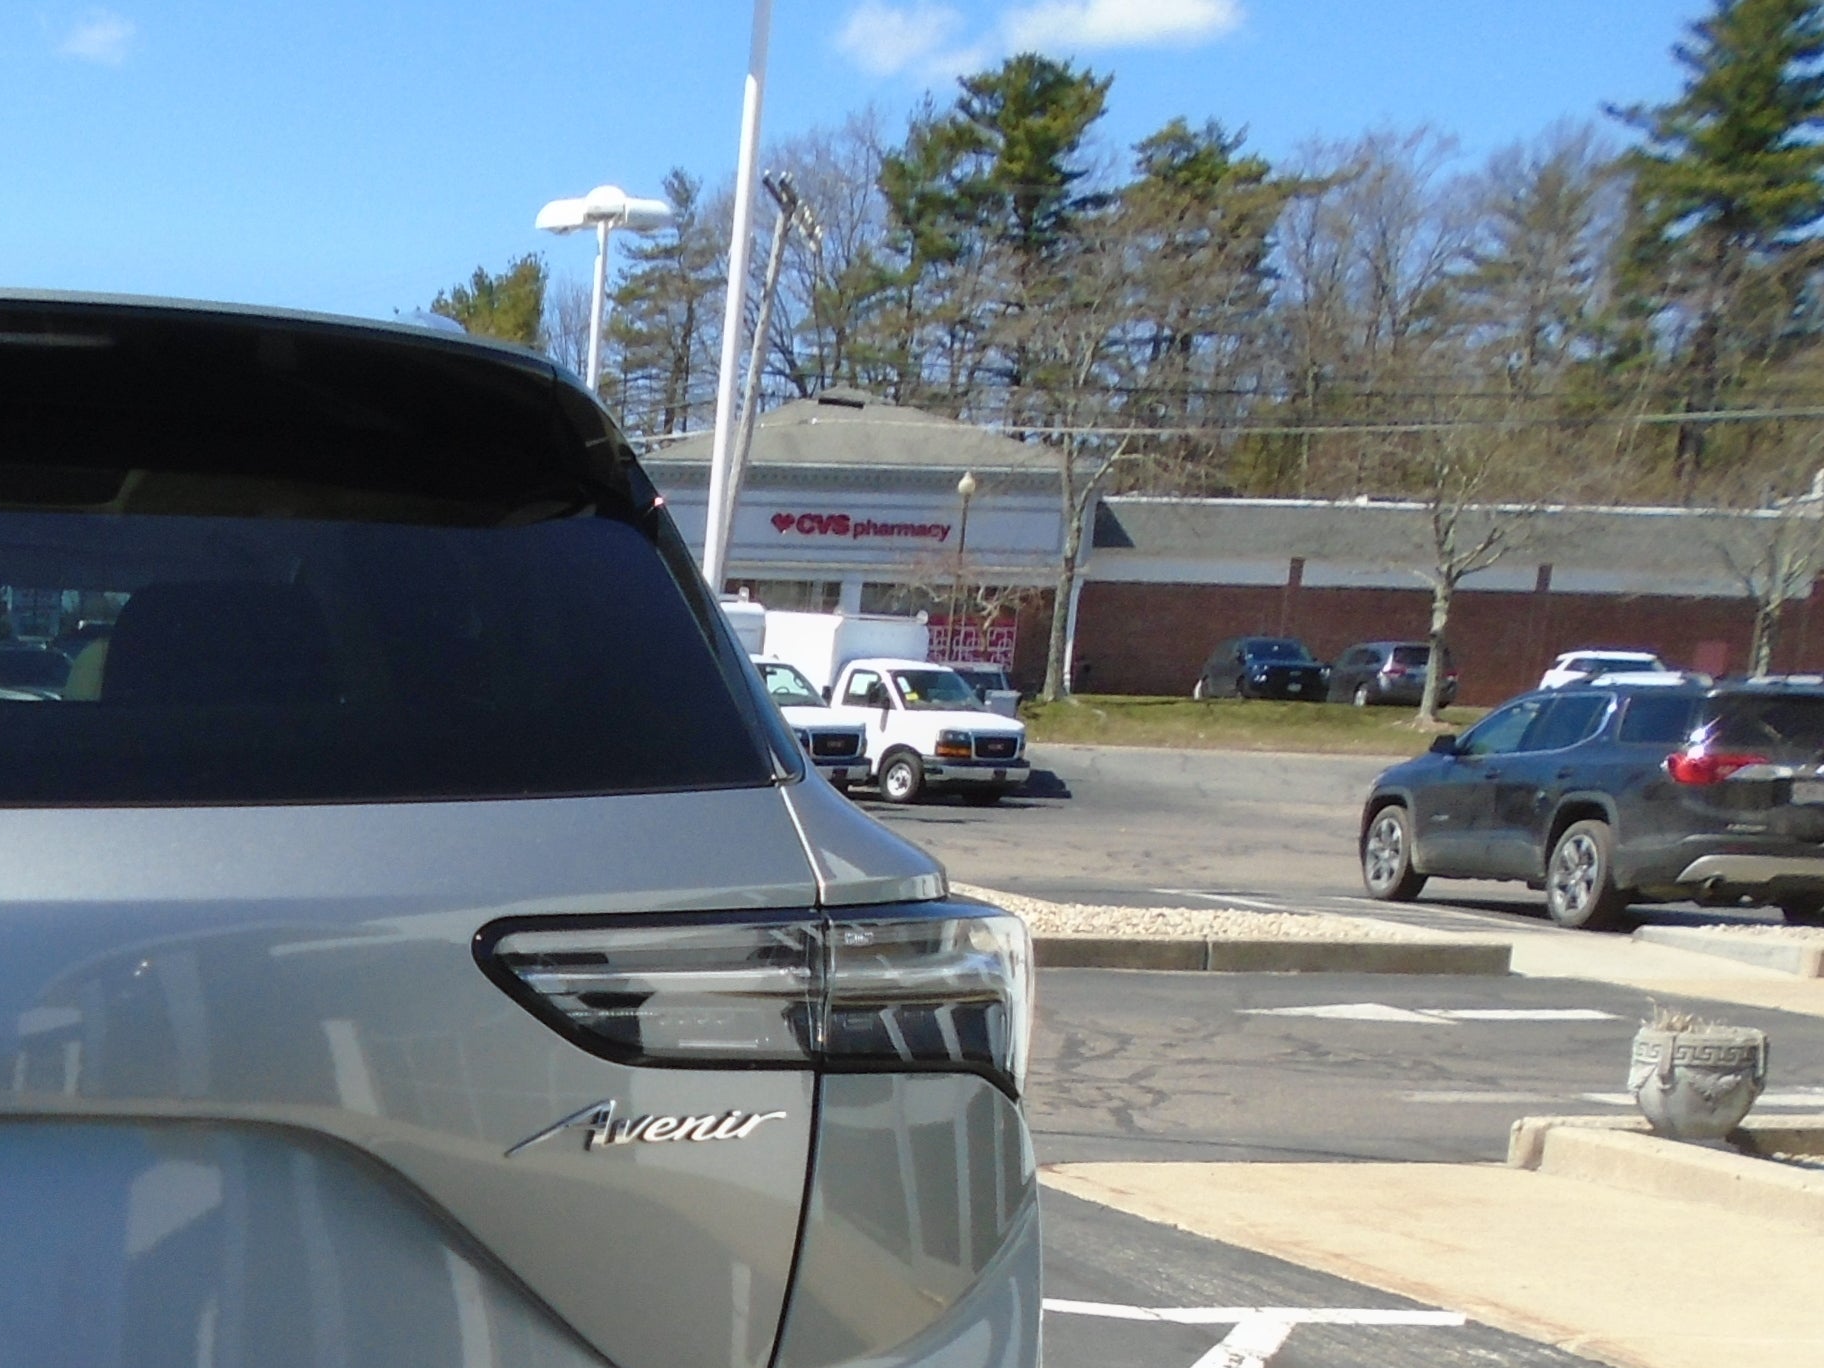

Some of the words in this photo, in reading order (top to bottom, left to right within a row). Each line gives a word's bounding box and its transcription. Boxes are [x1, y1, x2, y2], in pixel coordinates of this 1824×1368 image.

[796, 513, 851, 536] CVS
[853, 518, 952, 543] pharmacy
[503, 1099, 788, 1158] Avenir
